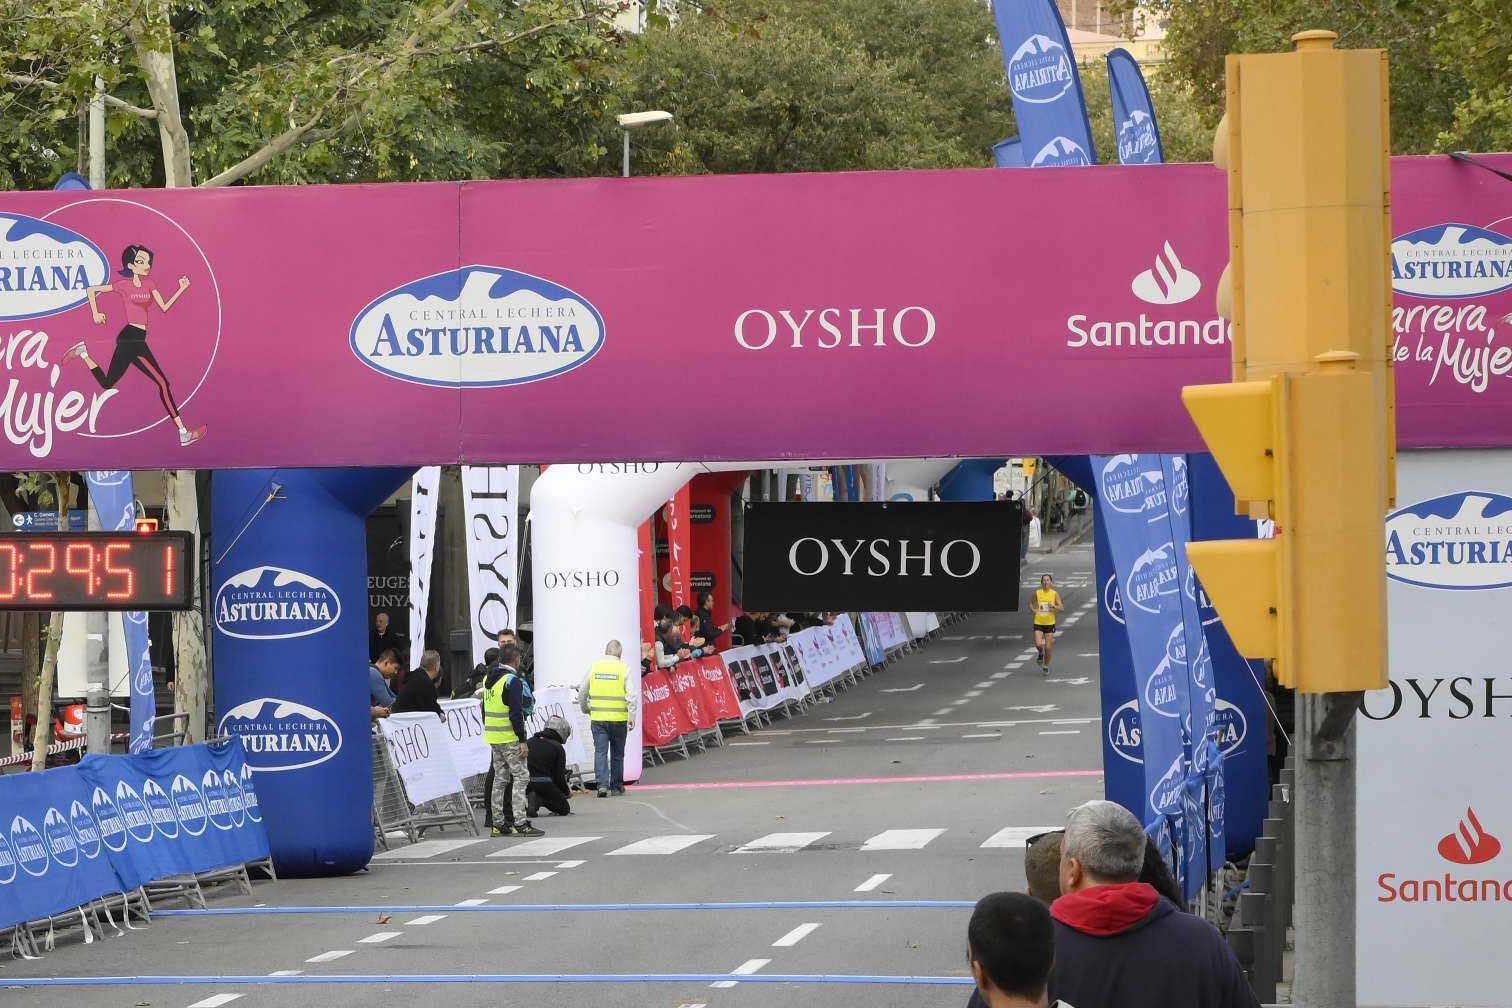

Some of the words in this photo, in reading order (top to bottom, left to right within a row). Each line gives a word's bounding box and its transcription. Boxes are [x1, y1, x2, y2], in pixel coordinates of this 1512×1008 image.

[12, 248, 85, 260] LECHERA
[409, 309, 487, 321] CENTRAL
[496, 306, 577, 320] LECHERA
[733, 306, 937, 350] OYSHO
[1392, 304, 1487, 333] arrera
[370, 313, 585, 358] ASTURIANA
[1066, 313, 1232, 347] Santand
[1415, 335, 1433, 362] la
[1428, 328, 1512, 393] Muje
[1412, 527, 1481, 536] CENTRAL
[788, 537, 981, 578] OYSHO
[1385, 529, 1512, 566] ASTURI
[544, 568, 620, 590] OYSHO
[219, 596, 332, 624] ASTURIANA
[231, 591, 274, 600] CENTRAL
[278, 591, 327, 599] LECHERA
[1358, 676, 1512, 720] OYSH
[233, 723, 274, 731] CENTRAL
[278, 723, 328, 731] LECHERA
[448, 705, 483, 742] OYS
[1378, 872, 1512, 903] Santan
